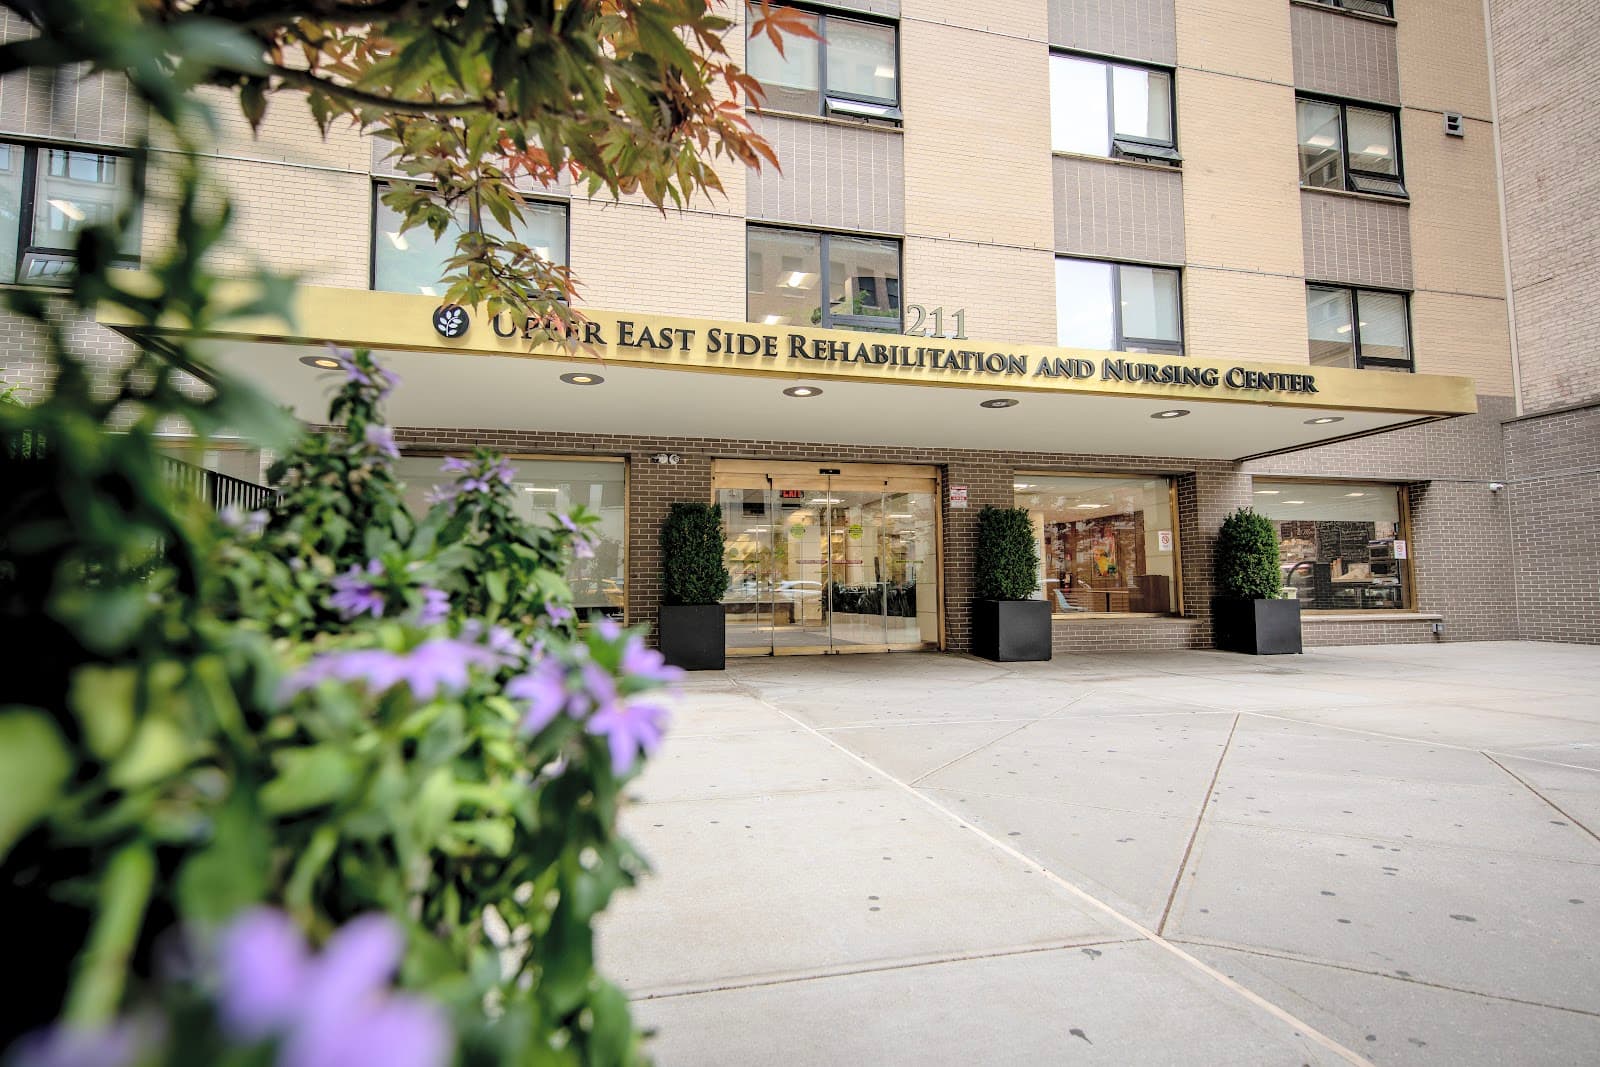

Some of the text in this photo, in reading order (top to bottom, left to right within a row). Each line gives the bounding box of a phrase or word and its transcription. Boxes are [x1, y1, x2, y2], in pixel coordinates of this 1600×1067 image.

[905, 304, 969, 341] 211
[617, 320, 696, 351] EAST
[707, 328, 778, 357] SIDE
[788, 333, 1028, 376] REHABILITATION
[1033, 356, 1095, 379] AND
[1102, 358, 1219, 388] NURSING
[1225, 366, 1320, 394] CENTER
